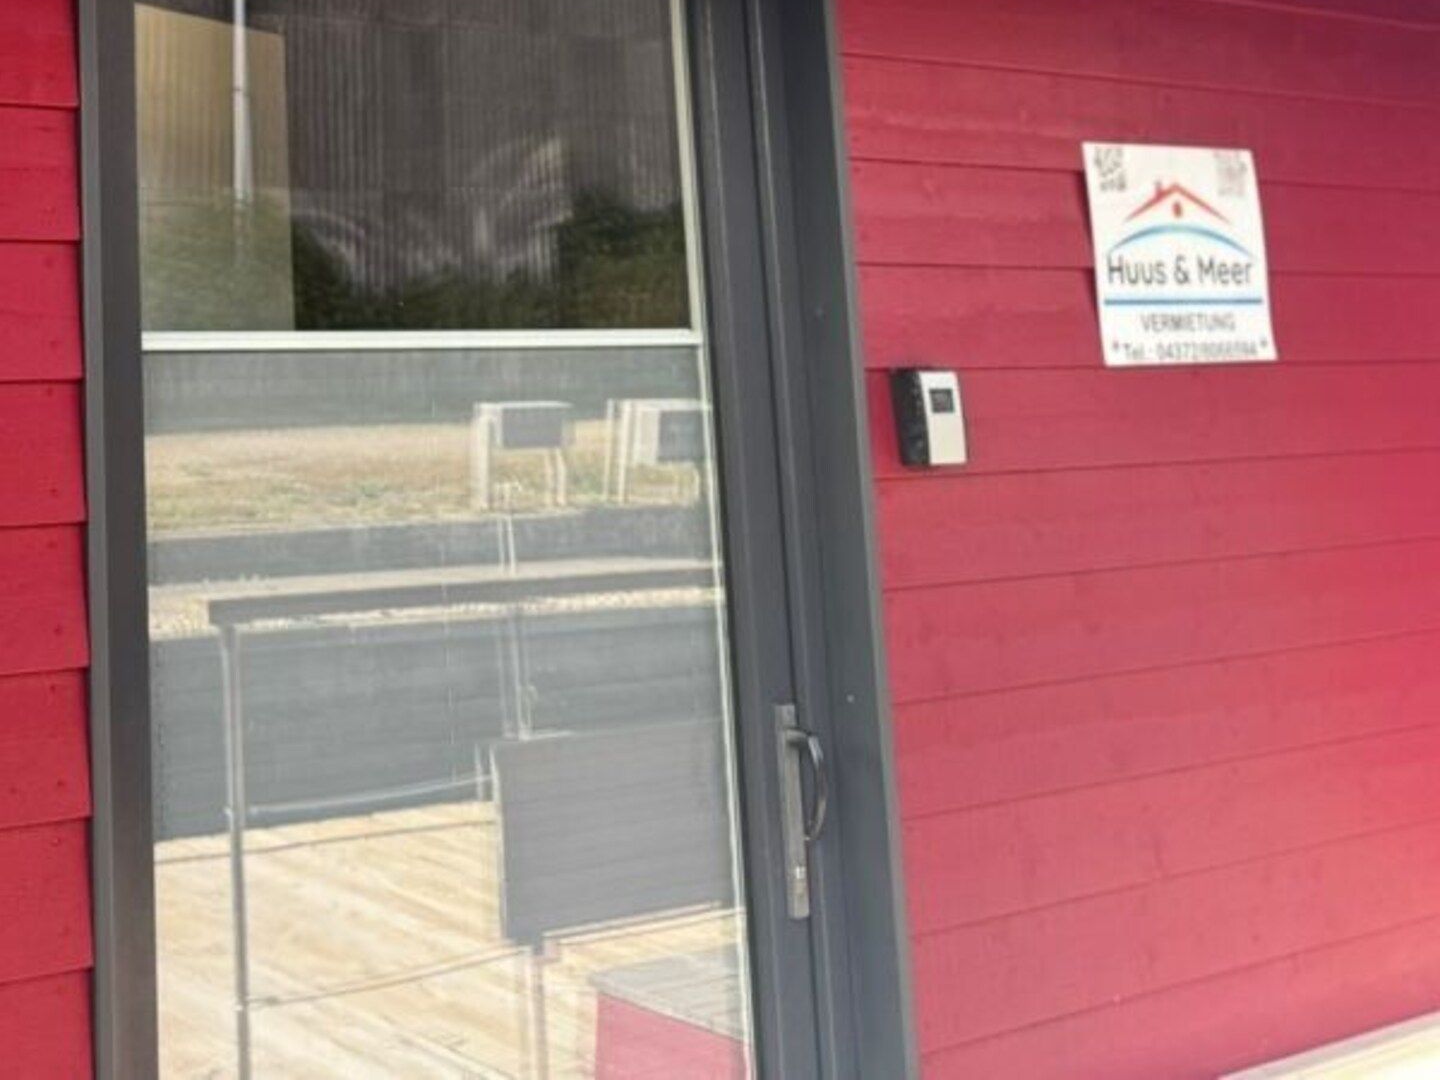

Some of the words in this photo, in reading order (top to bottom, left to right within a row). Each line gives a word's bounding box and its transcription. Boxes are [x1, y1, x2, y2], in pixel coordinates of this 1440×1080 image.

[1107, 254, 1168, 286] Huus
[1174, 254, 1192, 284] &
[1198, 256, 1253, 285] Meer
[1140, 312, 1237, 333] VERMIETUNG
